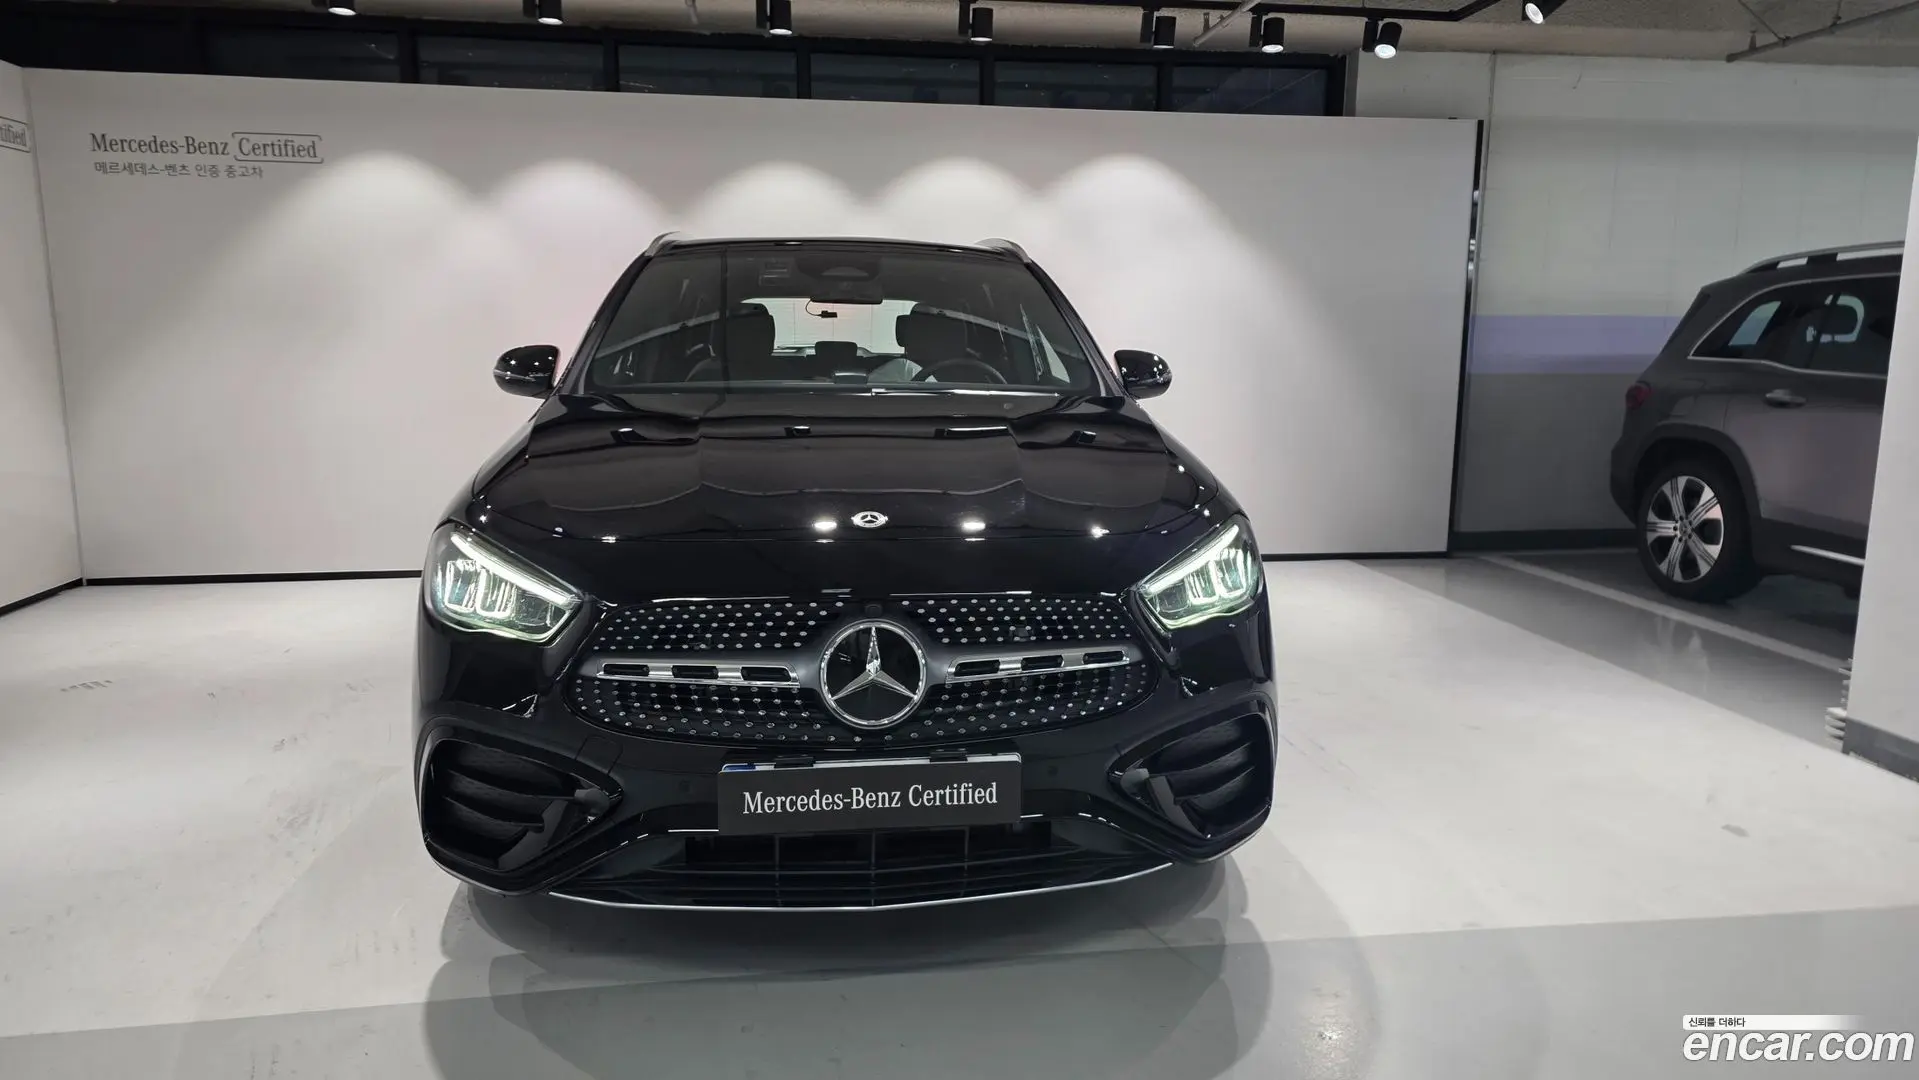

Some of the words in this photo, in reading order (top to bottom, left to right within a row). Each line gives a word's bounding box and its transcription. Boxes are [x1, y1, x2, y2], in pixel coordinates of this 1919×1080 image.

[89, 132, 230, 156] Mercedes-Benz
[238, 137, 318, 158] Certified
[94, 161, 192, 177] 메르세데스-벤츠
[195, 164, 220, 178] 인증
[224, 164, 263, 179] 중고차
[743, 787, 901, 815] Mercedes-Benz
[908, 782, 998, 807] Certified
